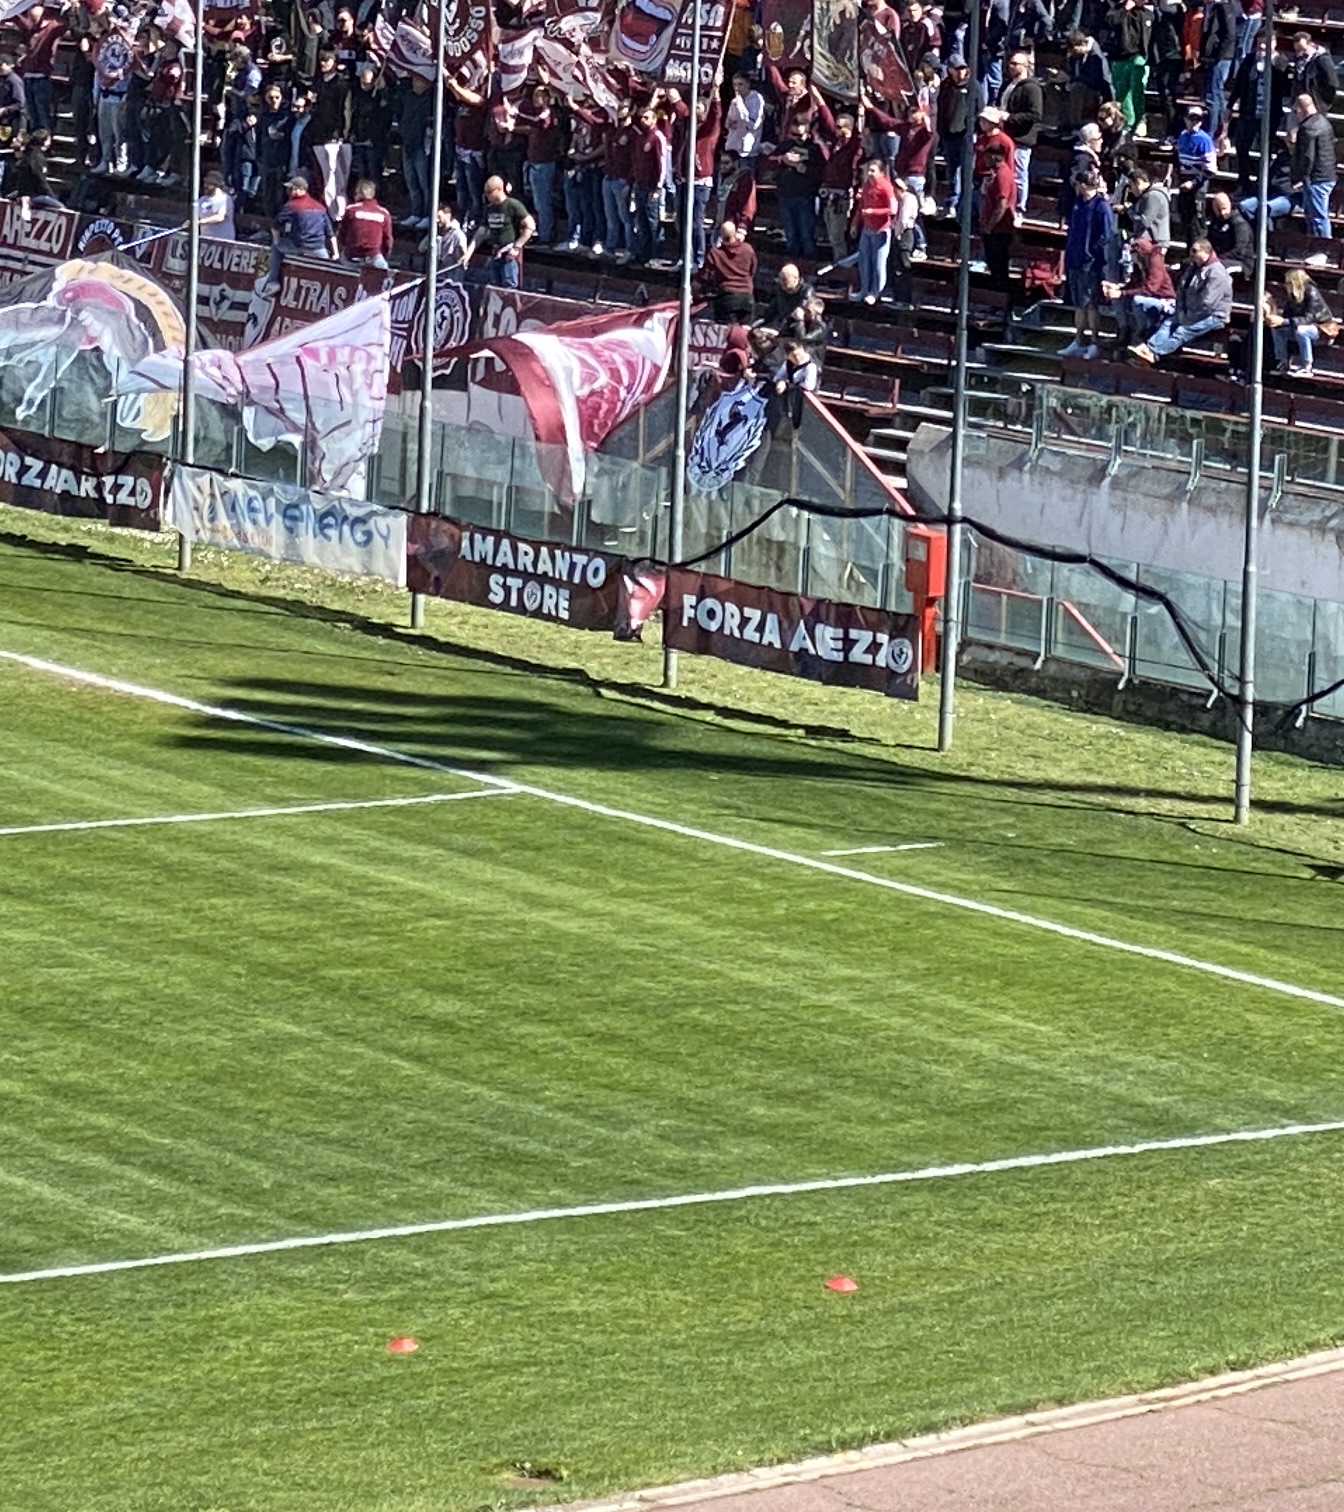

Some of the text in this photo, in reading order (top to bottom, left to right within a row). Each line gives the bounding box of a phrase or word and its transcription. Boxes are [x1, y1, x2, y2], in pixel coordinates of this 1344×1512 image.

[458, 531, 606, 589] AMARANTO
[488, 573, 570, 620] STORE
[682, 594, 782, 650] FORZA
